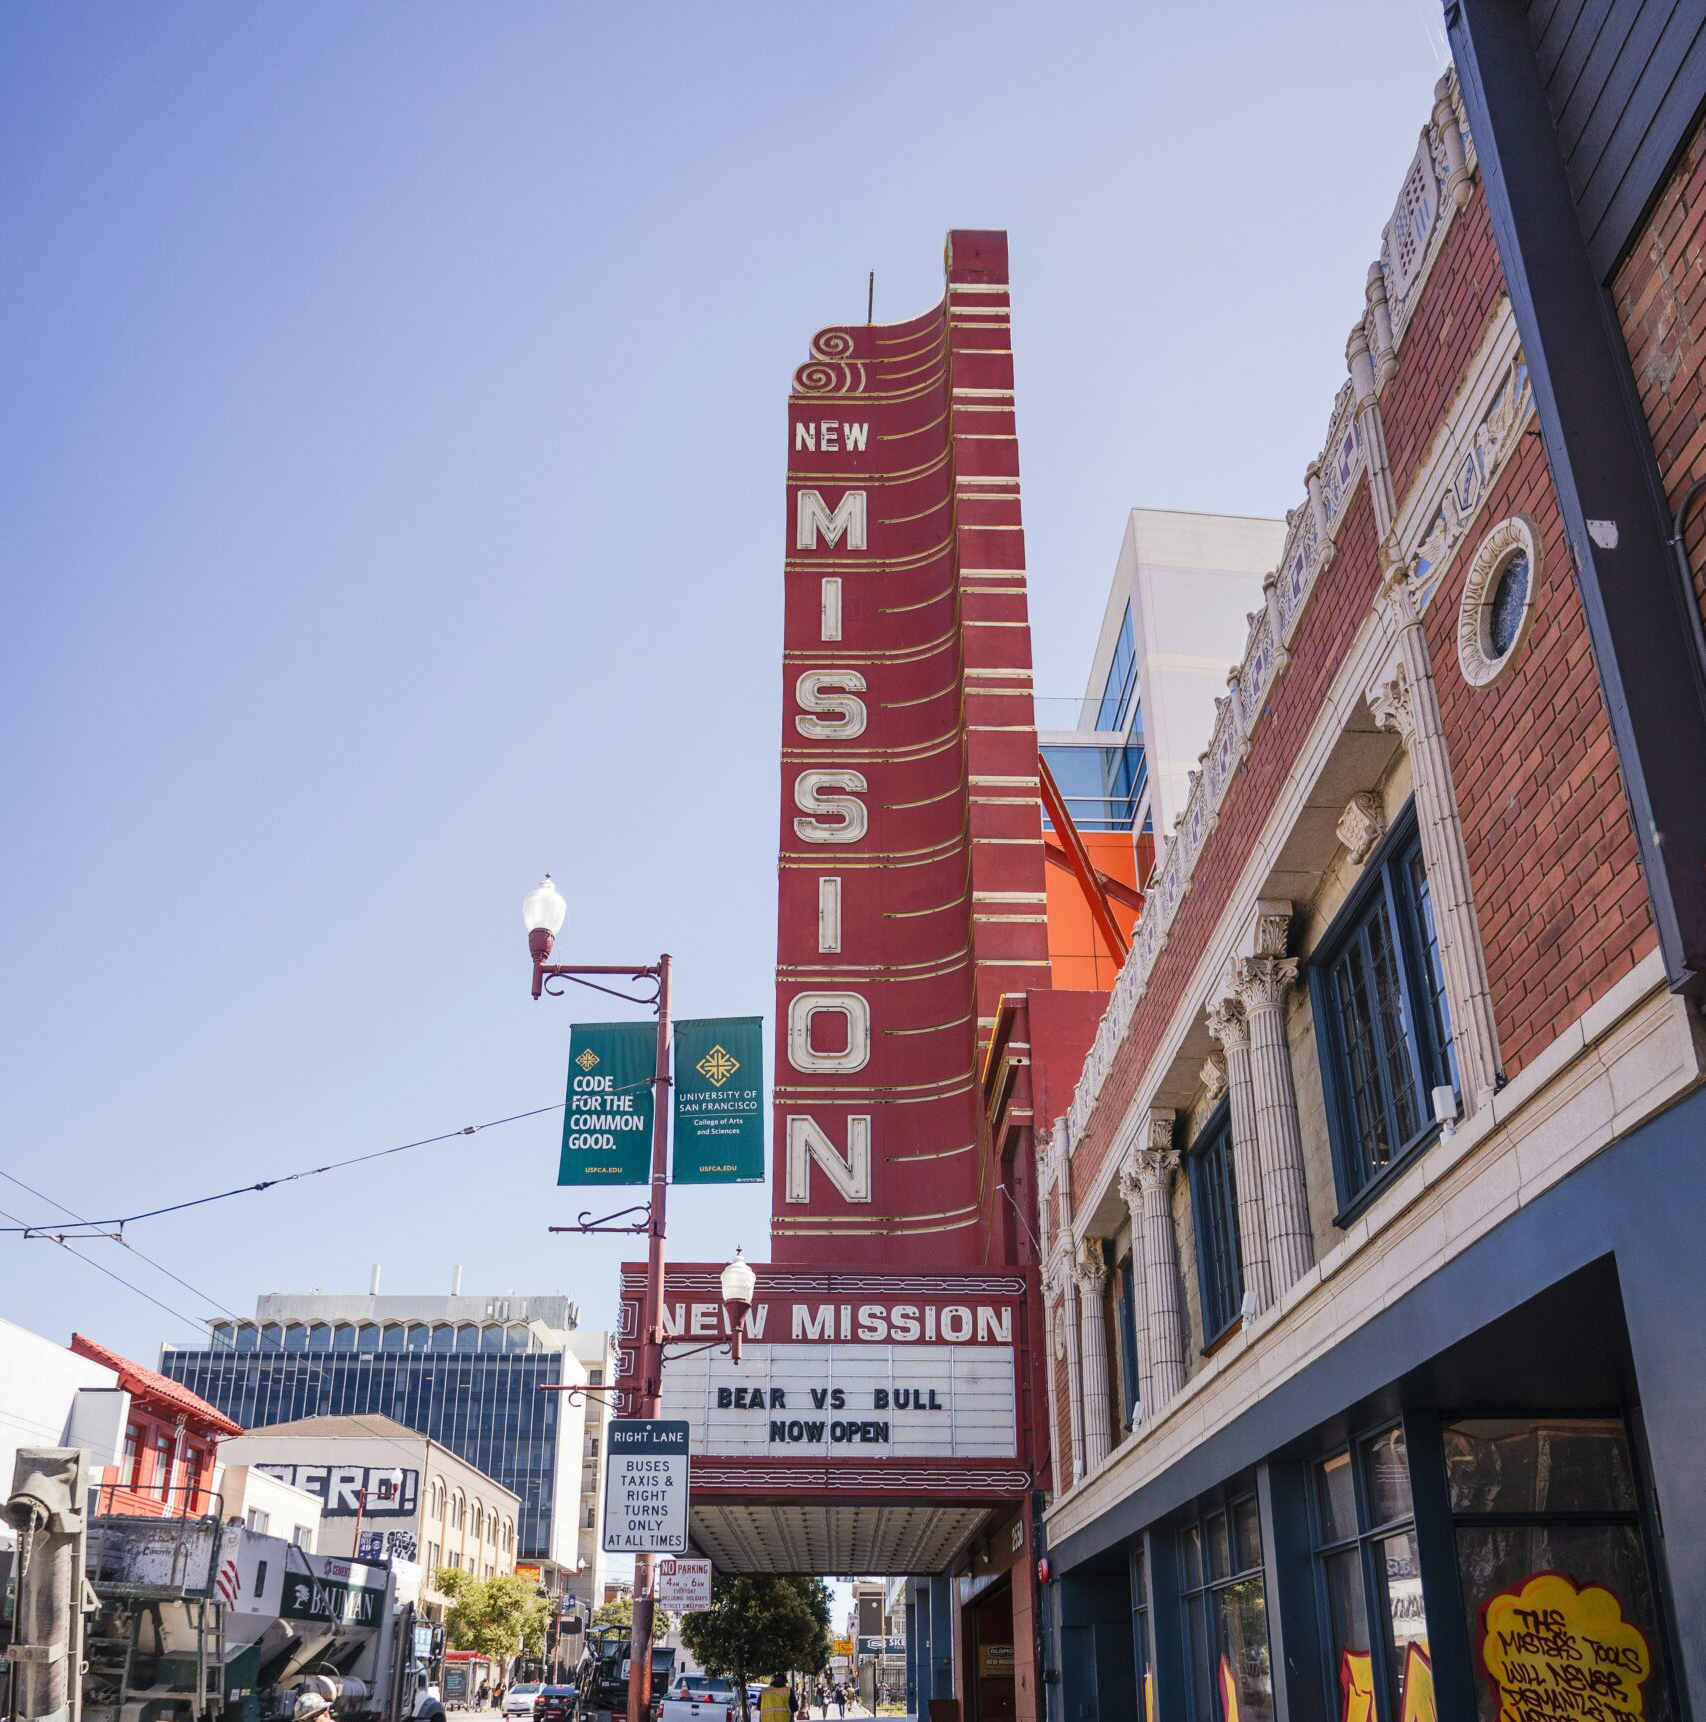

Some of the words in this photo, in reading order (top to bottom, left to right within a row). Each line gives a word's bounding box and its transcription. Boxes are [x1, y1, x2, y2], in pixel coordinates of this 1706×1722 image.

[795, 420, 869, 452] NEW
[785, 489, 872, 1204] MISSION
[573, 1076, 613, 1092] CODE
[572, 1095, 602, 1111] FOR
[604, 1095, 634, 1111] THE
[679, 1091, 740, 1102] UNIVERSITY
[744, 1090, 758, 1099] OF
[679, 1104, 699, 1112] SAN
[702, 1101, 757, 1111] FRANCISCO
[570, 1114, 644, 1131] COMMON
[711, 1127, 740, 1135] Sciences
[568, 1133, 617, 1150] GOOD.
[699, 1165, 738, 1173] USFCA.EDU
[791, 1304, 1013, 1342] MISSION
[717, 1387, 786, 1409] BEAR
[810, 1388, 846, 1410] VS
[873, 1388, 942, 1410] BULL
[614, 1432, 649, 1443] RIGHT
[652, 1432, 684, 1443] LANE
[769, 1420, 826, 1443] NOW
[830, 1420, 890, 1443] OPEN
[626, 1460, 670, 1473] BUSES
[621, 1475, 659, 1487] TAXIS
[664, 1475, 674, 1488] &
[627, 1490, 667, 1502] RIGHT
[624, 1505, 669, 1517] TURNS
[628, 1519, 664, 1532] ONLY
[608, 1534, 622, 1546] AT
[625, 1534, 644, 1547] ALL
[650, 1534, 682, 1547] TIMES
[661, 1561, 675, 1575] NO
[678, 1564, 708, 1575] PARKING
[309, 1583, 375, 1621] BAUMAN
[1513, 1608, 1566, 1634] THE
[1581, 1636, 1643, 1674] TOOLS
[1501, 1660, 1547, 1687] WILL
[1545, 1661, 1629, 1703] NEVER
